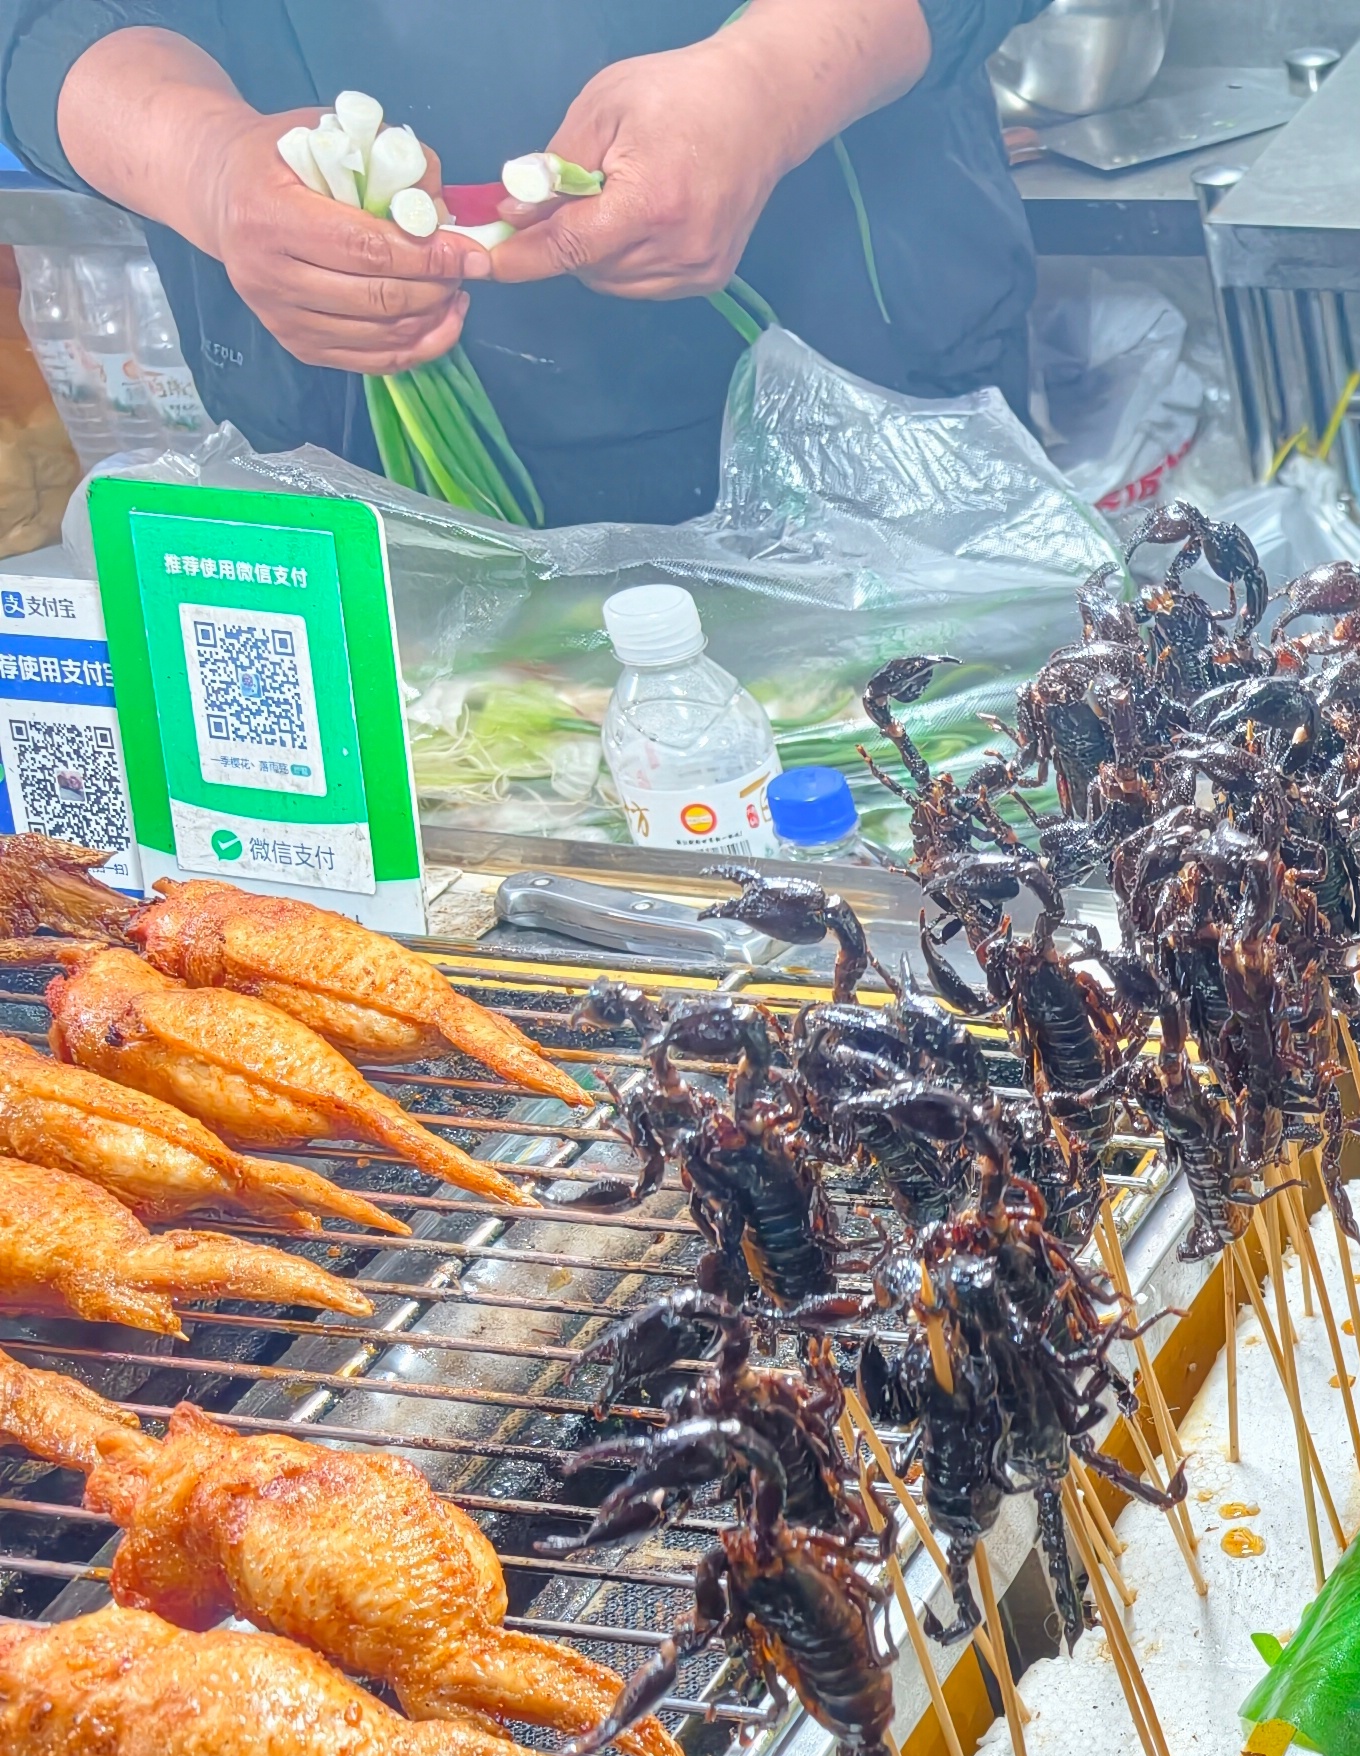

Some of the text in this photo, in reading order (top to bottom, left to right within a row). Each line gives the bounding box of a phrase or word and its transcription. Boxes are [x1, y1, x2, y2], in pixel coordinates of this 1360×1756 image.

[163, 552, 309, 588] 推荐使用微信支付
[25, 595, 77, 619] 支付宝
[248, 837, 336, 872] 微信支付
